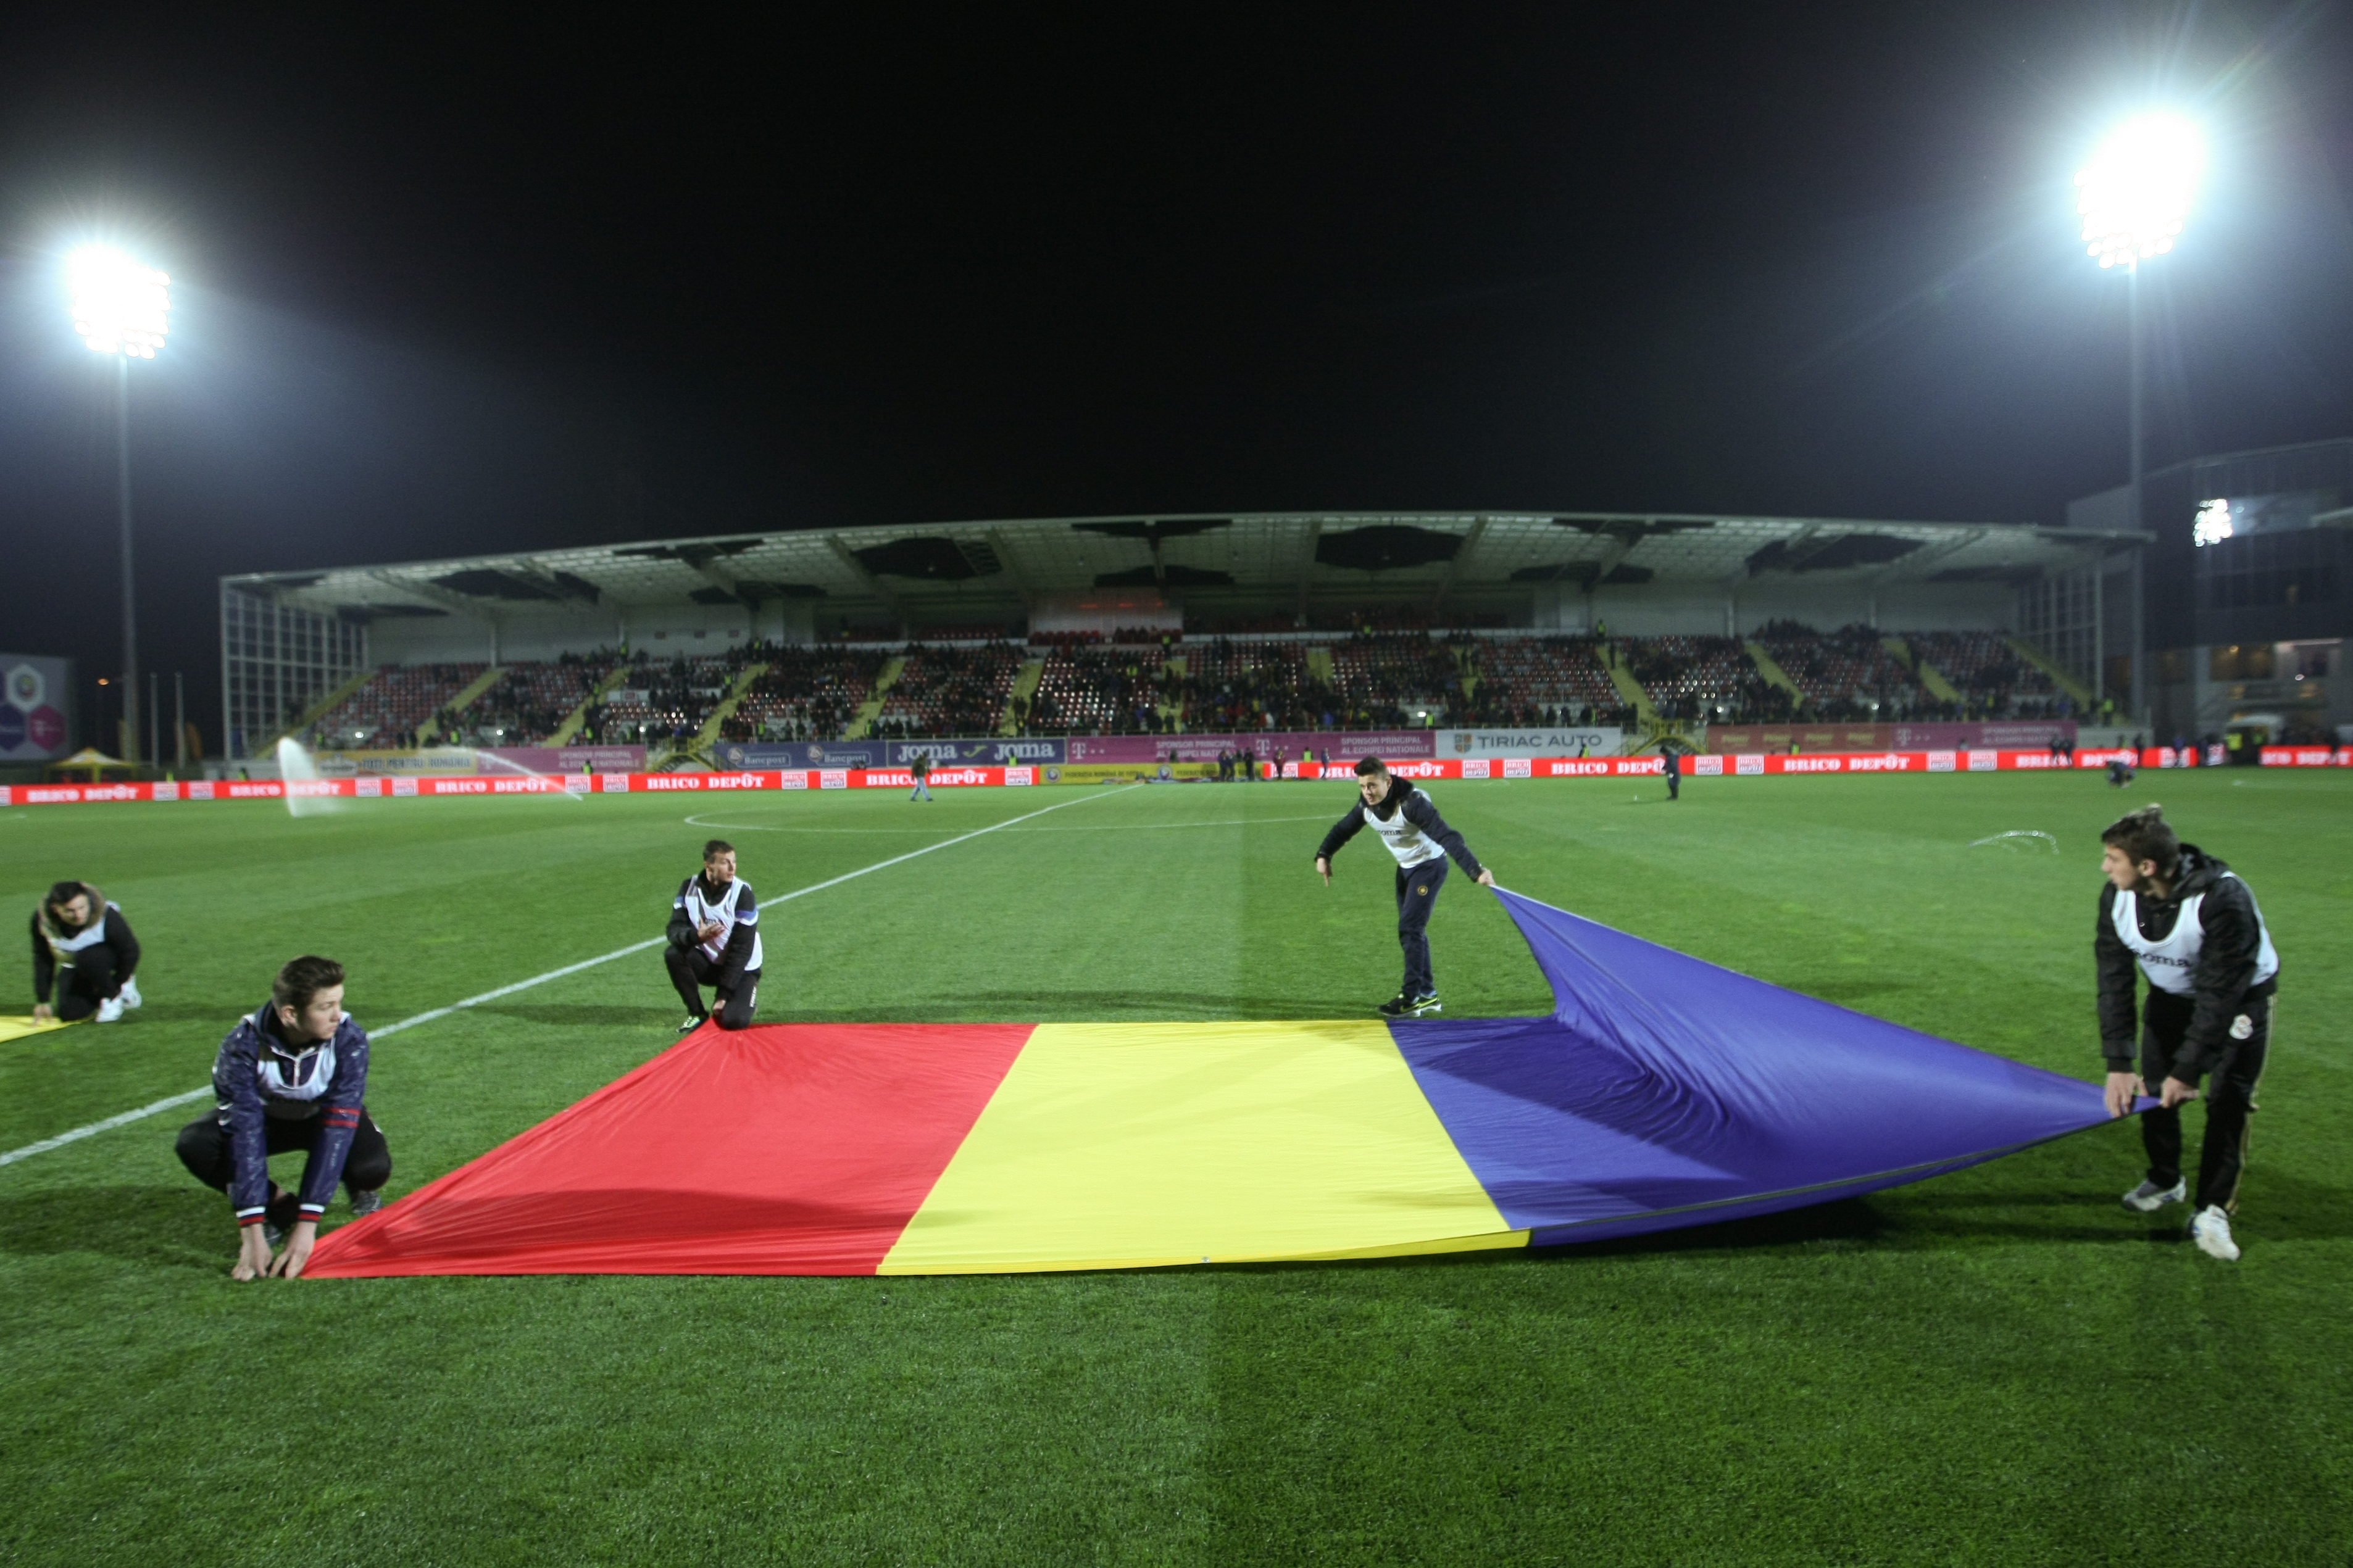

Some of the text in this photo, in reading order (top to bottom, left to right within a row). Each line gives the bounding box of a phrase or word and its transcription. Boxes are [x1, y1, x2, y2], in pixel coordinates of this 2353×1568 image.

[1341, 736, 1422, 745] SPONSOR PRINCIPAL
[1478, 734, 1602, 749] TIRIAC AUTO
[744, 755, 787, 766] Bancpost
[824, 754, 867, 765] Bancpost
[1551, 758, 1666, 775] BRICO DEPÔ
[1784, 753, 1910, 771] BRICO DEPÔT
[435, 776, 549, 794] BRICO DEPÔT
[647, 773, 765, 790] BRICO DEPÔT
[930, 769, 987, 785] DEPÔT
